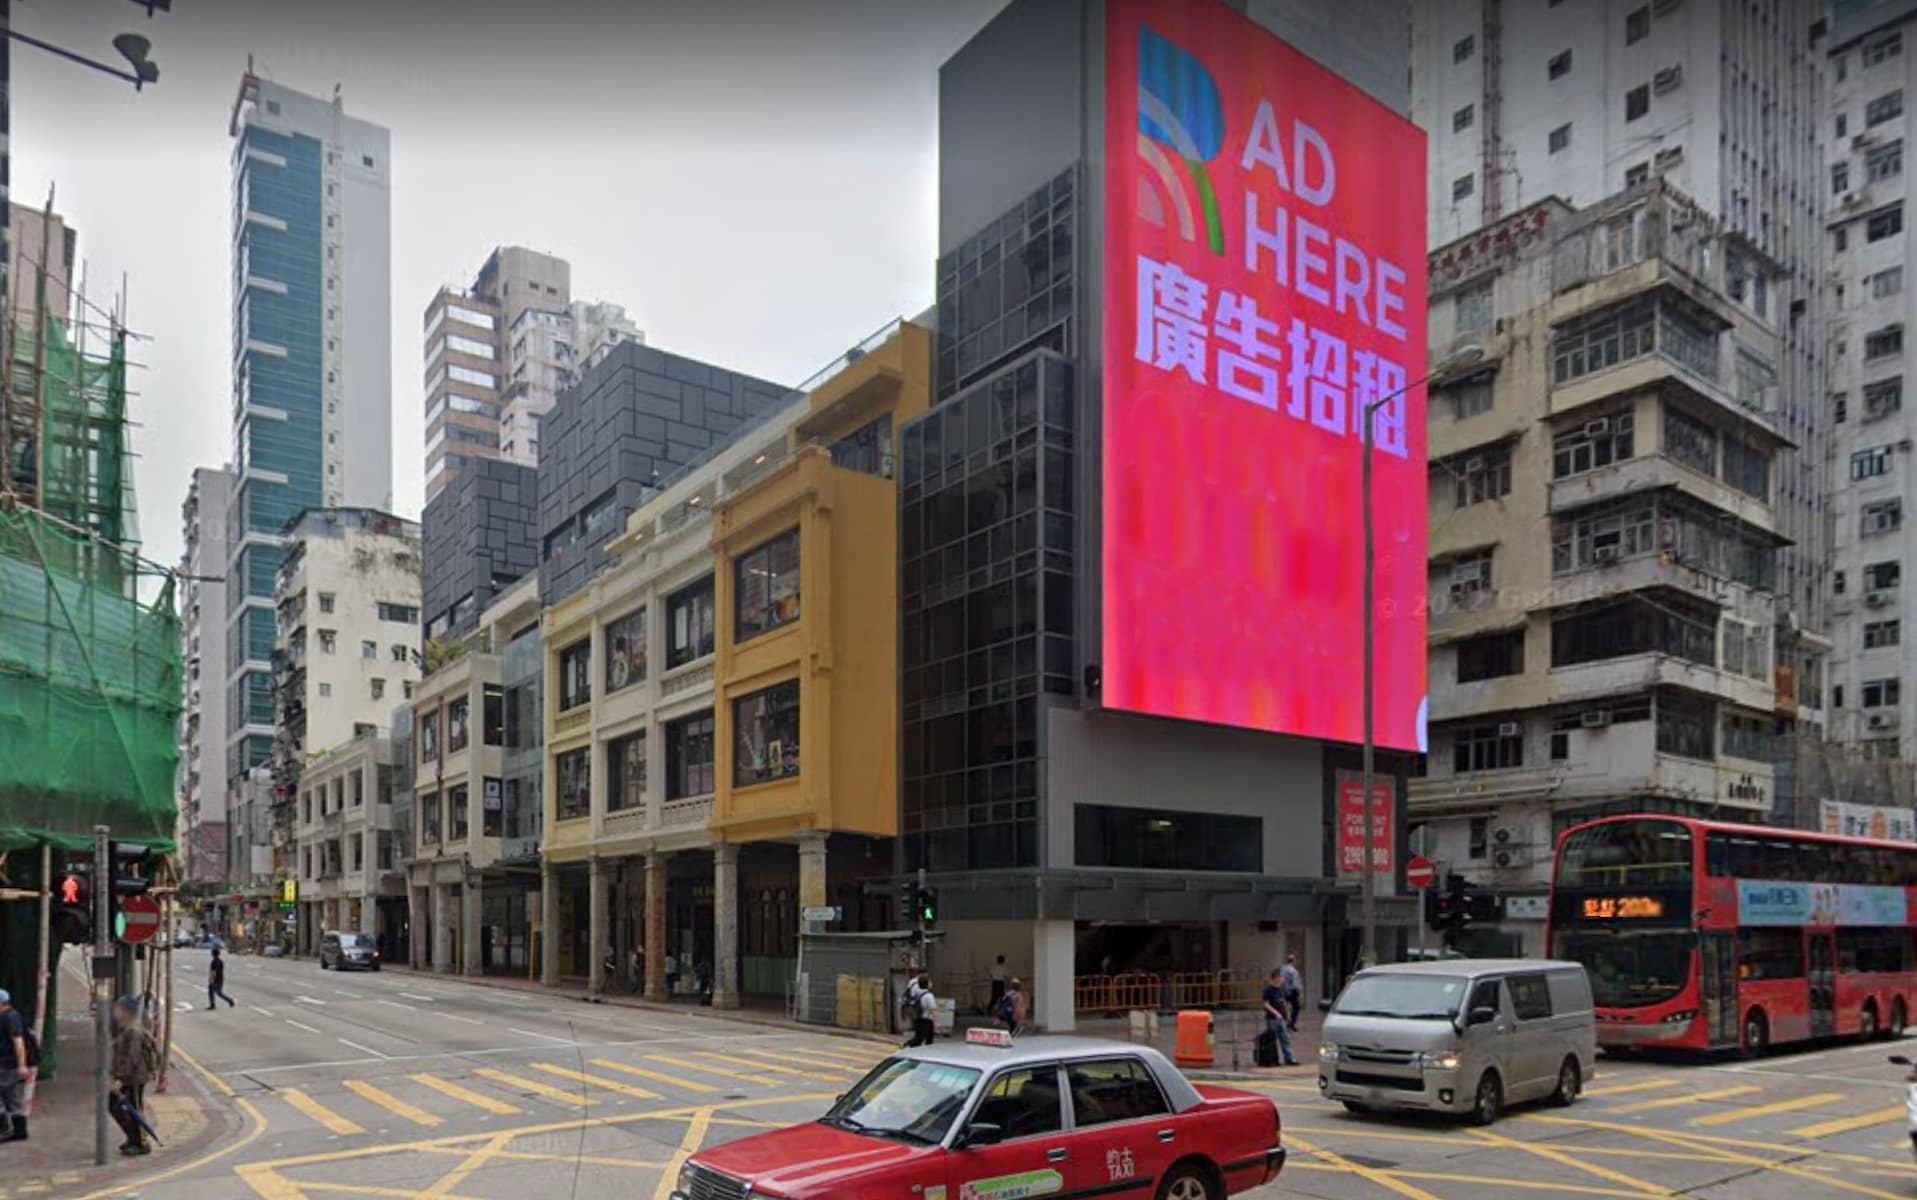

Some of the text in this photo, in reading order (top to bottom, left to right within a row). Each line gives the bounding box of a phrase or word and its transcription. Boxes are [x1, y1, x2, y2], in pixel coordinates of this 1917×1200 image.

[1240, 98, 1336, 207] AD
[1243, 192, 1408, 342] HERE
[1134, 255, 1409, 459] 廣告招租
[1108, 1158, 1135, 1181] TAXI
